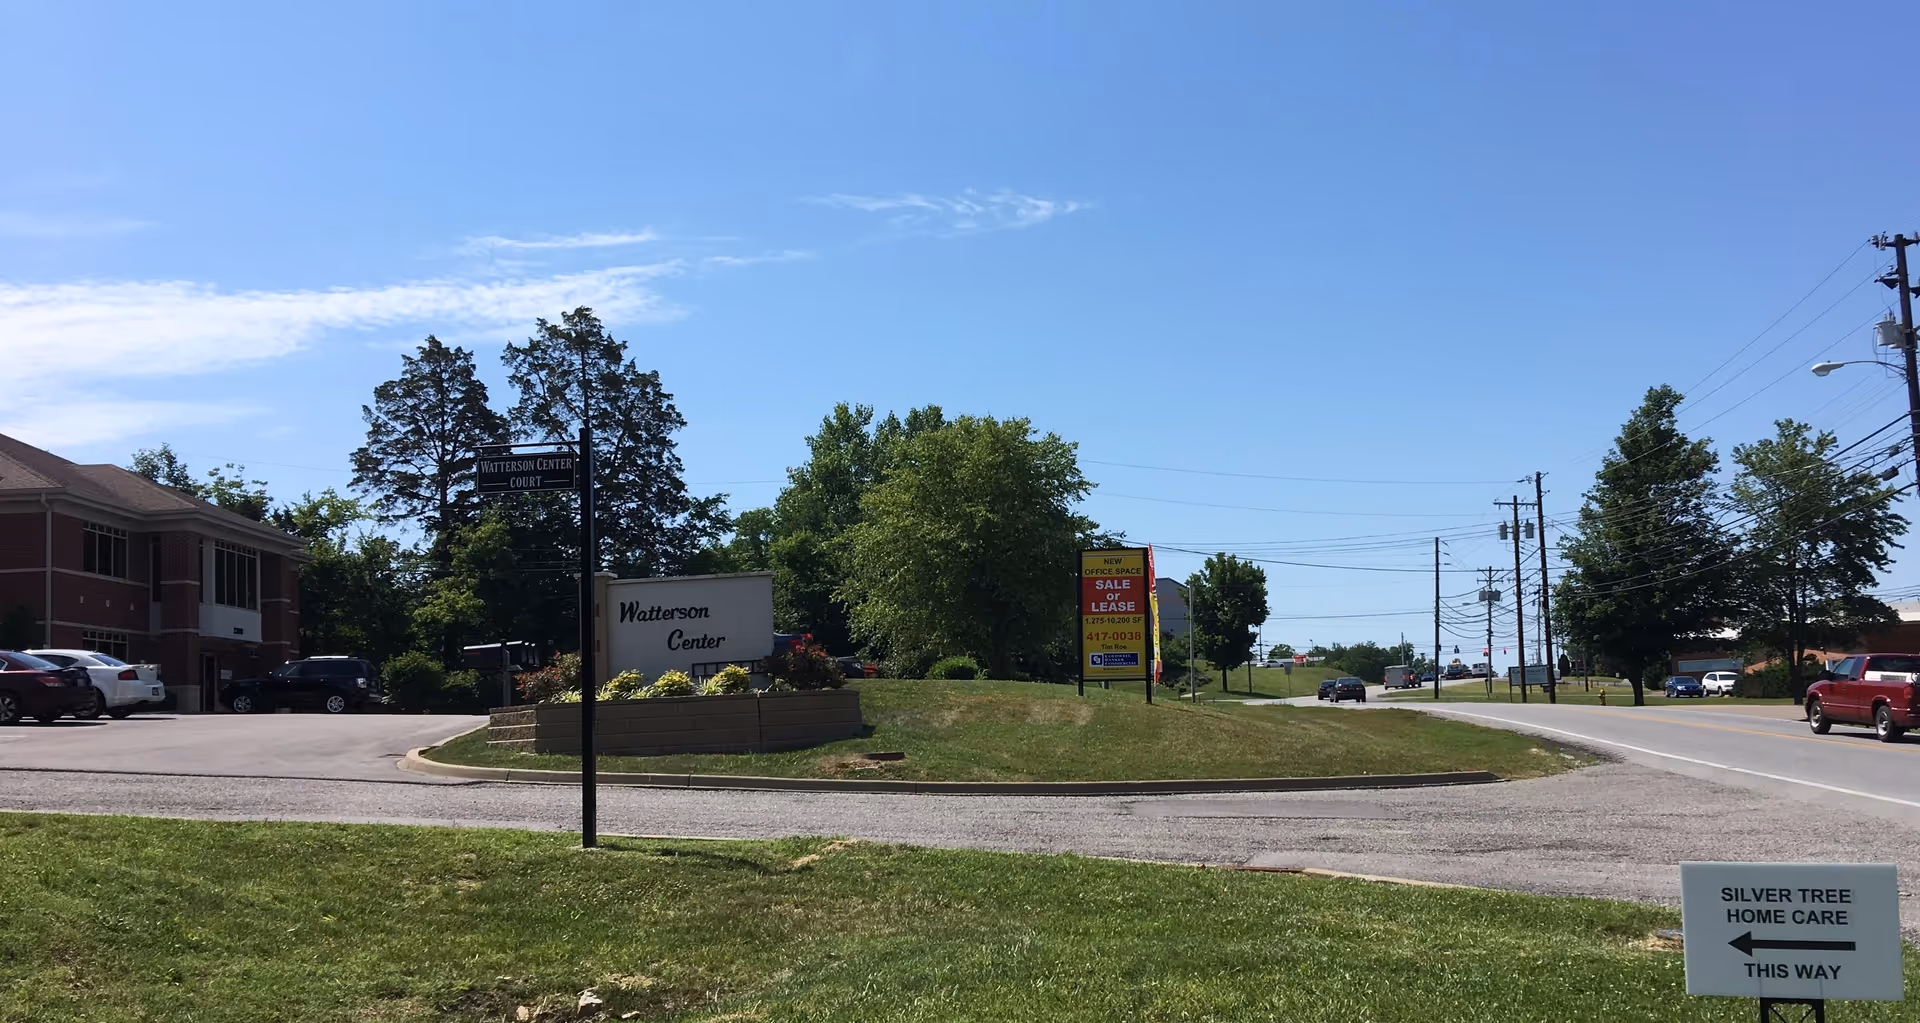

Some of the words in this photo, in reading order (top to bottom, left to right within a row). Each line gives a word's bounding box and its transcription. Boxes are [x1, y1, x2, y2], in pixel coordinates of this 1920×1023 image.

[481, 460, 535, 473] WATTERSON
[536, 458, 572, 470] CENTER
[510, 476, 542, 488] COURT
[1084, 568, 1113, 576] OFFICE
[1115, 567, 1141, 575] SPACE
[1095, 579, 1131, 590] SALE
[1106, 592, 1121, 601] or
[620, 600, 710, 623] Watterson
[1091, 601, 1136, 612] LEASE
[1132, 616, 1143, 624] SF
[667, 629, 726, 650] Center
[1086, 631, 1142, 642] 417-0038
[1721, 887, 1793, 903] SILVER
[1797, 888, 1852, 904] TREE
[1727, 908, 1786, 924] HOME
[1791, 909, 1849, 925] CARE
[1744, 962, 1789, 979] THIS
[1794, 964, 1842, 980] WAY
